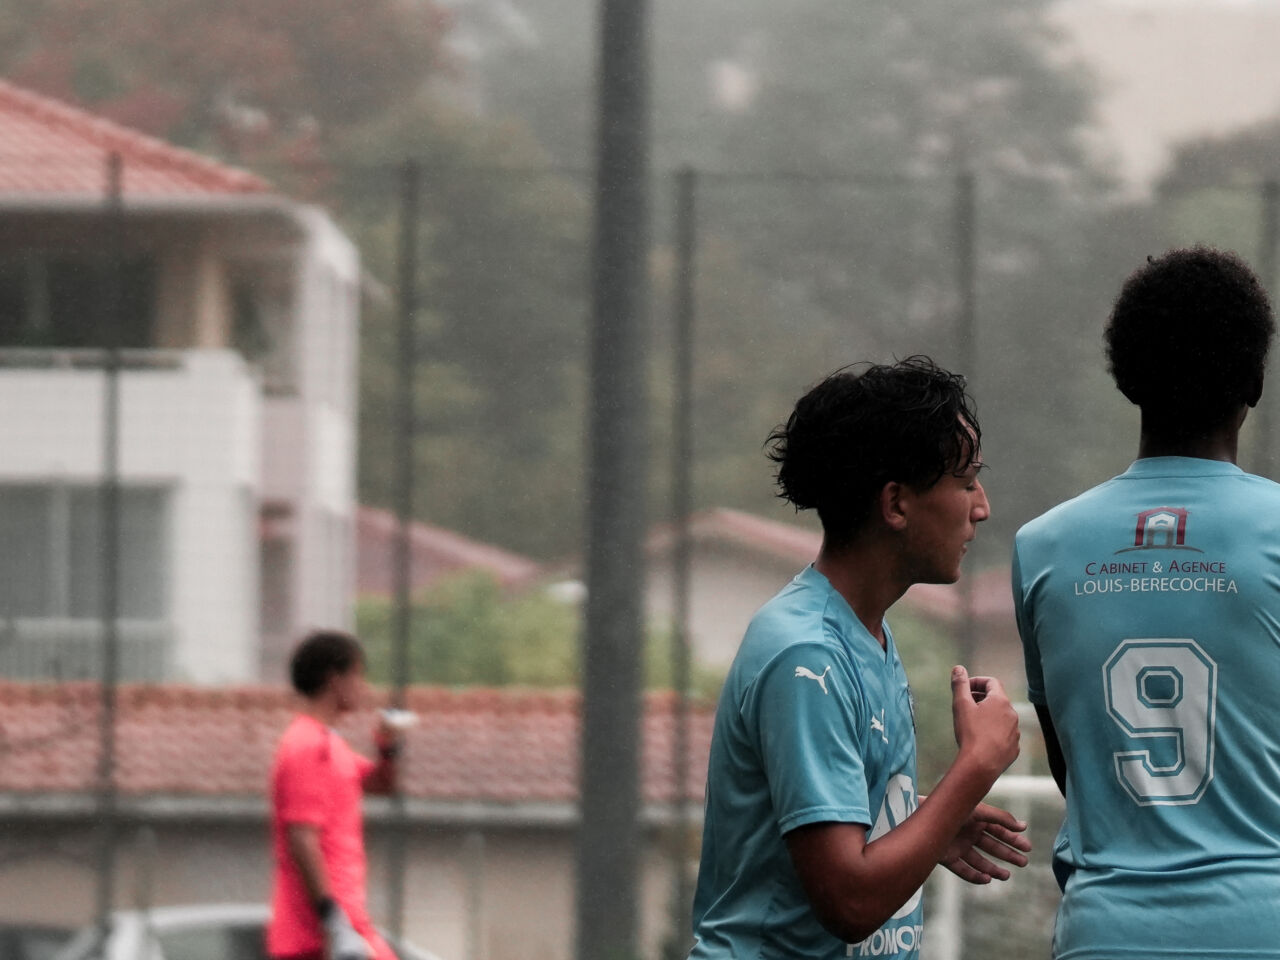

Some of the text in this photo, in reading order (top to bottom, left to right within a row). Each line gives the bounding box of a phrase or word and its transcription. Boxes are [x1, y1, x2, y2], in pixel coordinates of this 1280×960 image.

[1085, 560, 1226, 575] CABINET & AGENCE
[1074, 578, 1238, 596] LOUIS-BERECOCHEA
[1102, 638, 1218, 807] 9
